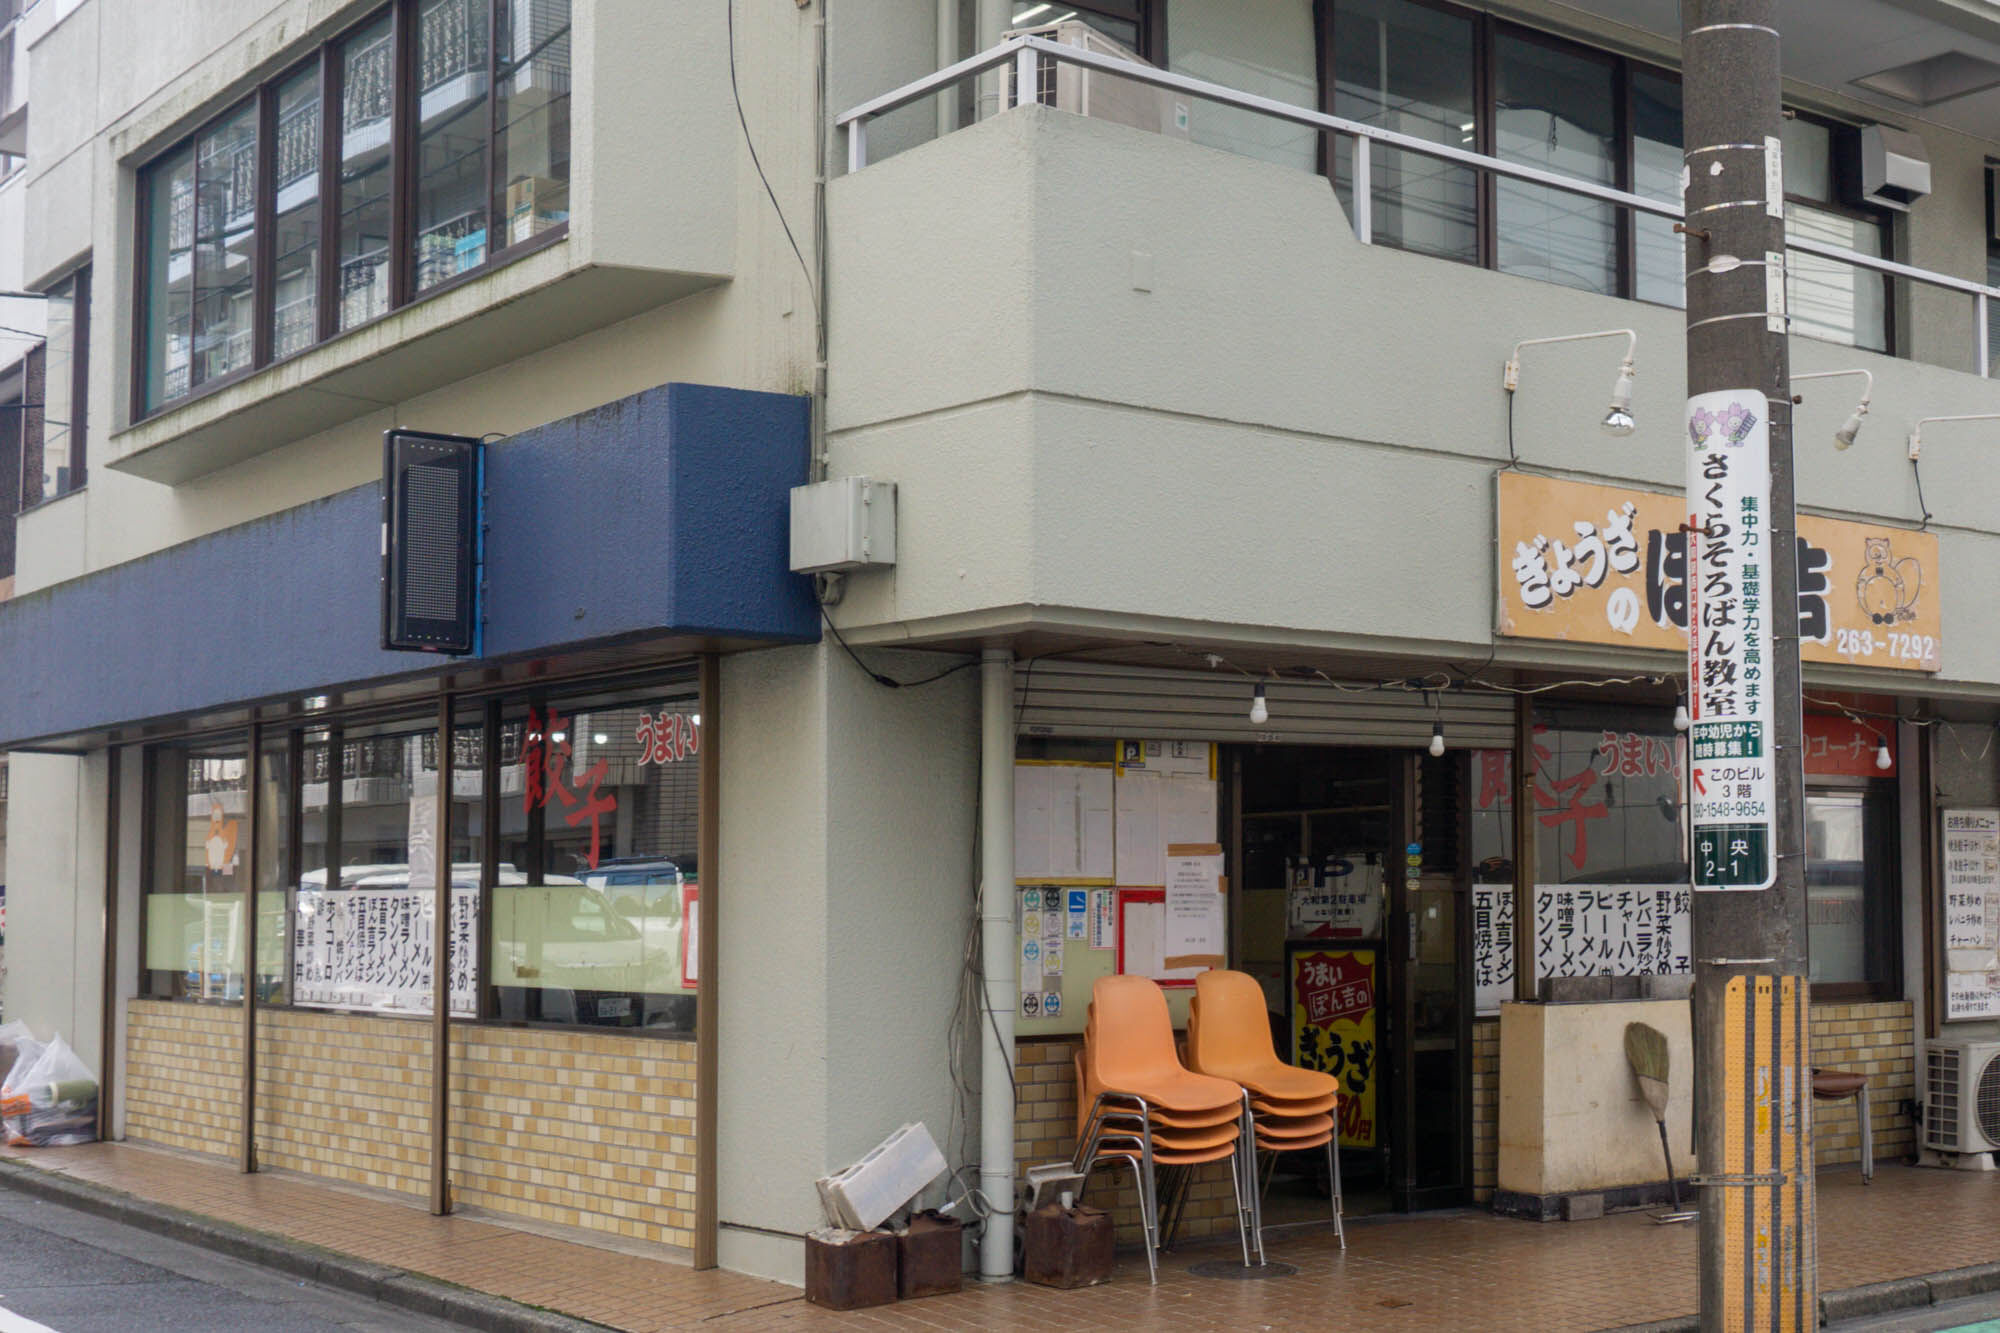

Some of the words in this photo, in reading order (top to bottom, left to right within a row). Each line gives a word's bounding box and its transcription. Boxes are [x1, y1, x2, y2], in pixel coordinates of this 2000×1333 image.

[1512, 500, 1640, 609] ぎょうざ
[1701, 453, 1738, 717] さくらそろばん教室
[1605, 587, 1640, 634] の
[1740, 496, 1761, 715] 集中力・基礎学力を高めます
[1837, 628, 1934, 660] 263-7292
[520, 706, 617, 871] 餃子
[1711, 767, 1765, 782] このビル
[1705, 860, 1739, 877] 2-1
[1304, 961, 1343, 985] うまい
[1475, 891, 1492, 988] 五目焼そば
[1537, 892, 1555, 977] タンメン
[1557, 892, 1576, 977] 味噌ラーメン
[1577, 890, 1595, 977] ラーメン
[1616, 890, 1635, 977] チャーハン
[1656, 890, 1673, 975] 野菜炒め
[1311, 986, 1368, 1018] ぽん吉の
[1299, 1025, 1374, 1094] ぎょうざ
